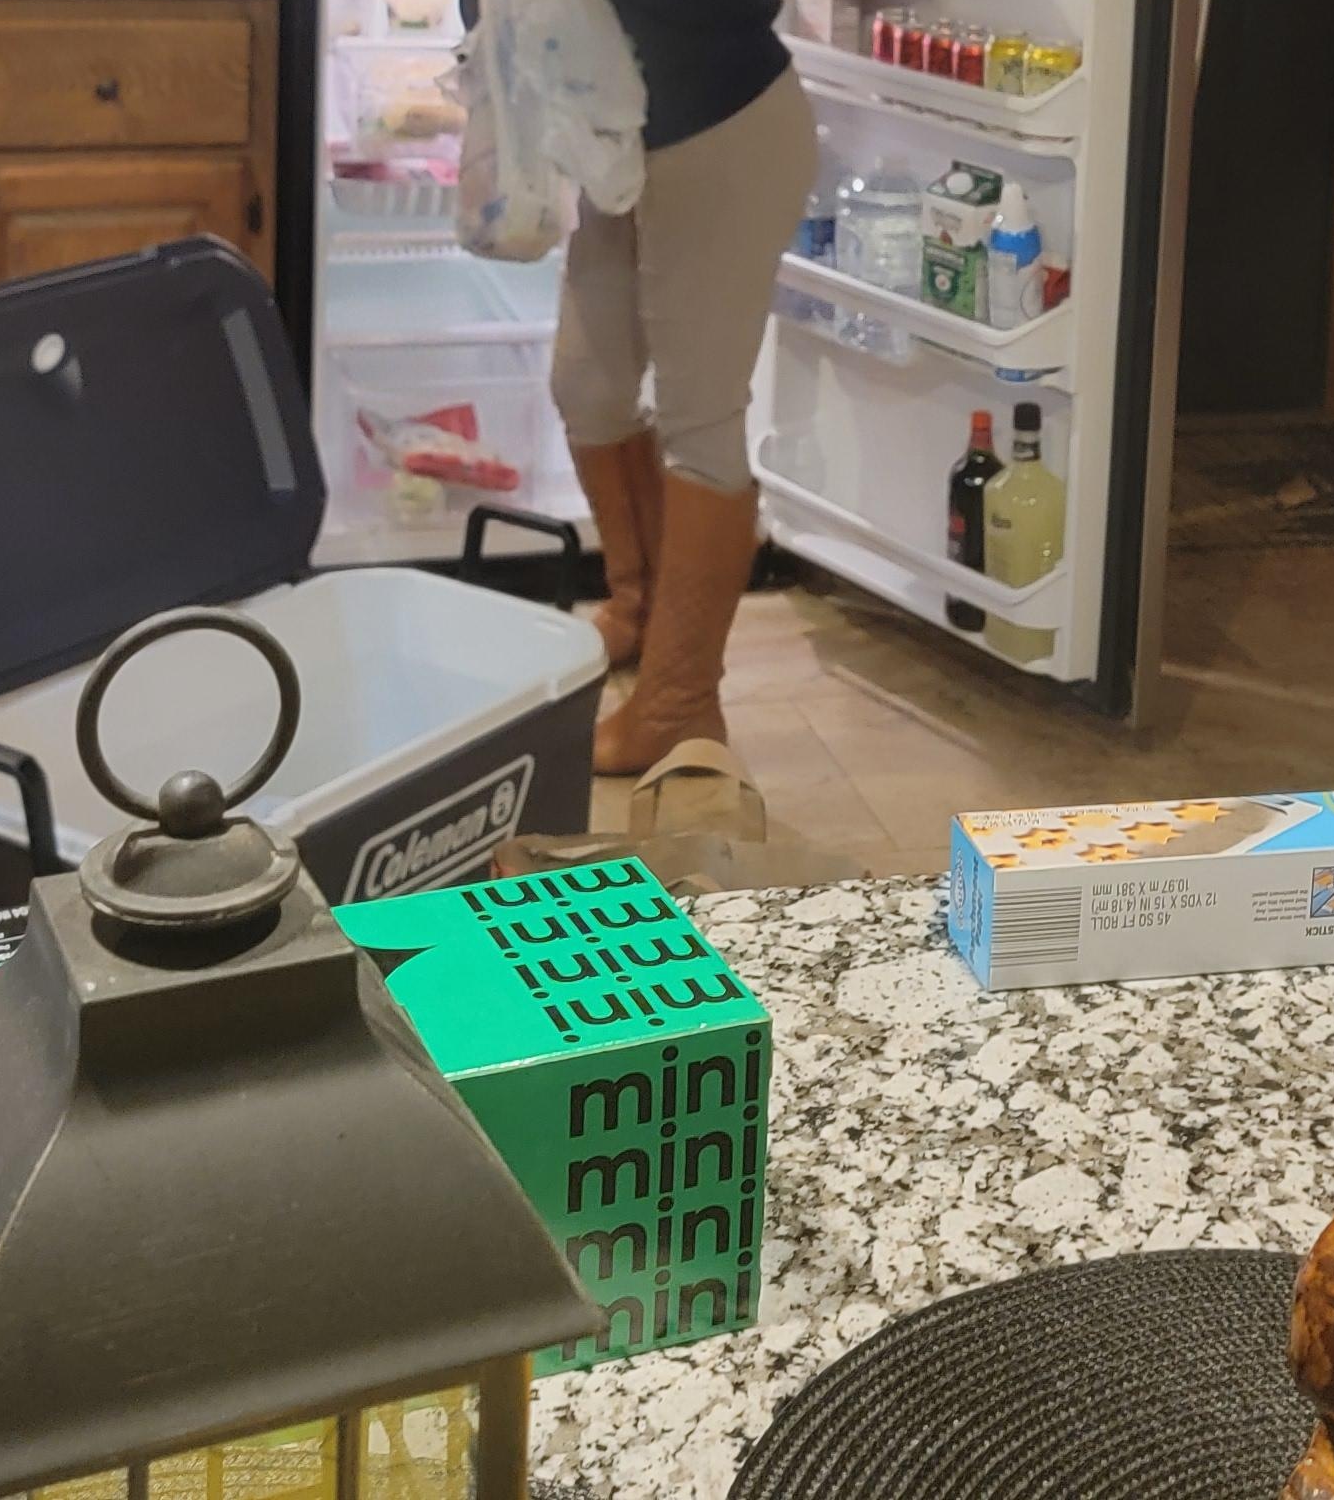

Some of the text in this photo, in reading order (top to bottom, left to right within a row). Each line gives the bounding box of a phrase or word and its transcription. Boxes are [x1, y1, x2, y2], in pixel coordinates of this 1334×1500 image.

[365, 804, 488, 897] Coleman
[461, 863, 646, 921] mini
[1092, 878, 1189, 896] 10.97 m X 381 mm
[1139, 896, 1151, 911] IN
[1154, 896, 1165, 910] 15
[1170, 895, 1179, 909] X
[1181, 893, 1203, 908] YDS
[1205, 892, 1217, 906] 12
[1091, 915, 1119, 931] ROLL
[1121, 913, 1136, 928] FT
[1157, 911, 1171, 925] 45
[487, 897, 677, 958] mini
[513, 934, 710, 998] mini
[543, 973, 745, 1043] mini
[569, 1029, 762, 1139] mini
[567, 1104, 760, 1214] mini
[566, 1178, 757, 1280] mini
